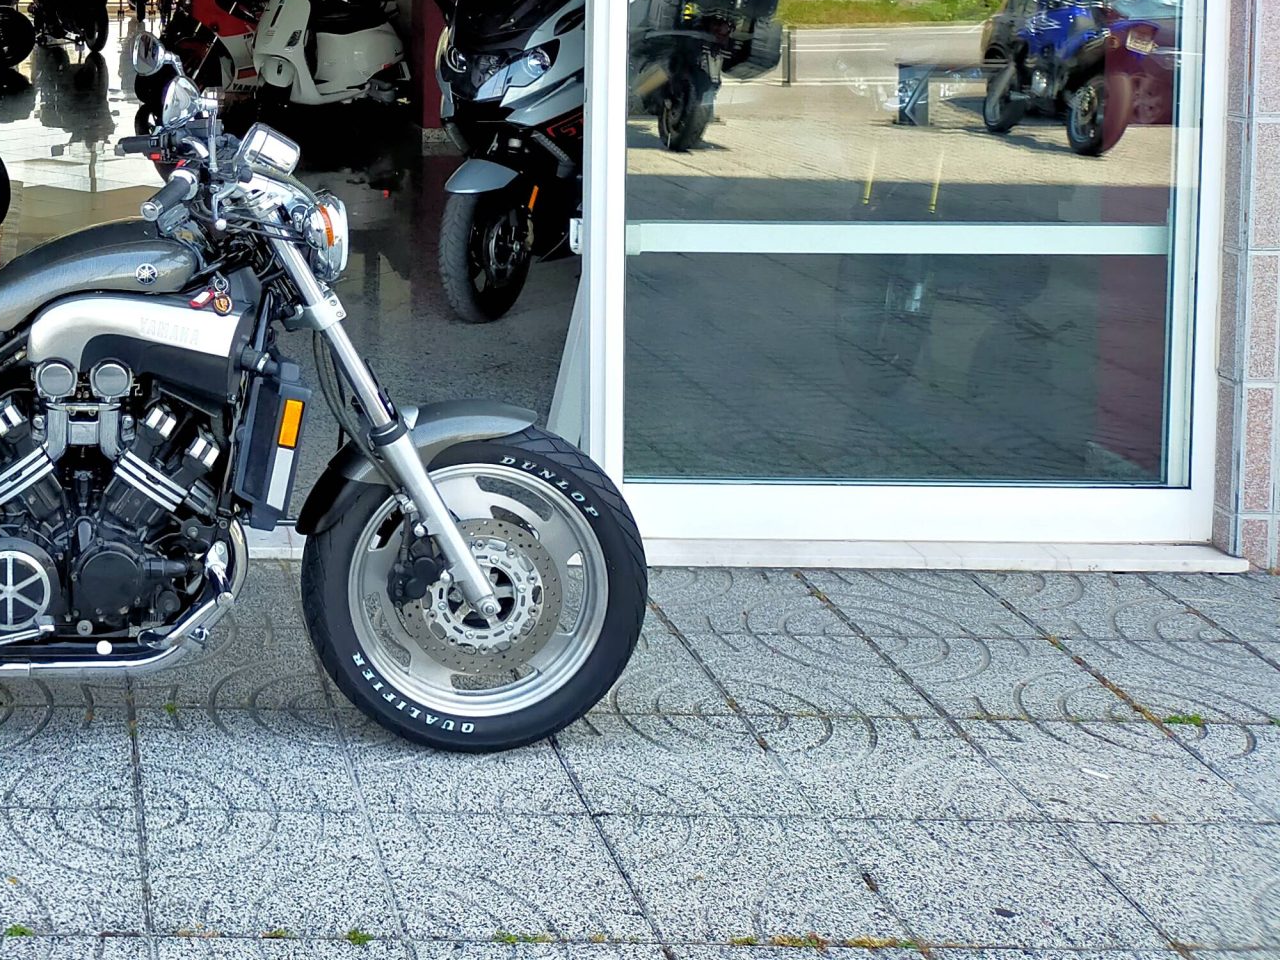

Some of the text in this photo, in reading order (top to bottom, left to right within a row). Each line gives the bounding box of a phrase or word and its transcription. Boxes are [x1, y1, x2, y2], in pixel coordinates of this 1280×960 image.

[140, 317, 200, 346] YAMAHA
[499, 456, 600, 517] DUNLOP
[352, 651, 475, 734] QUALIFIER
